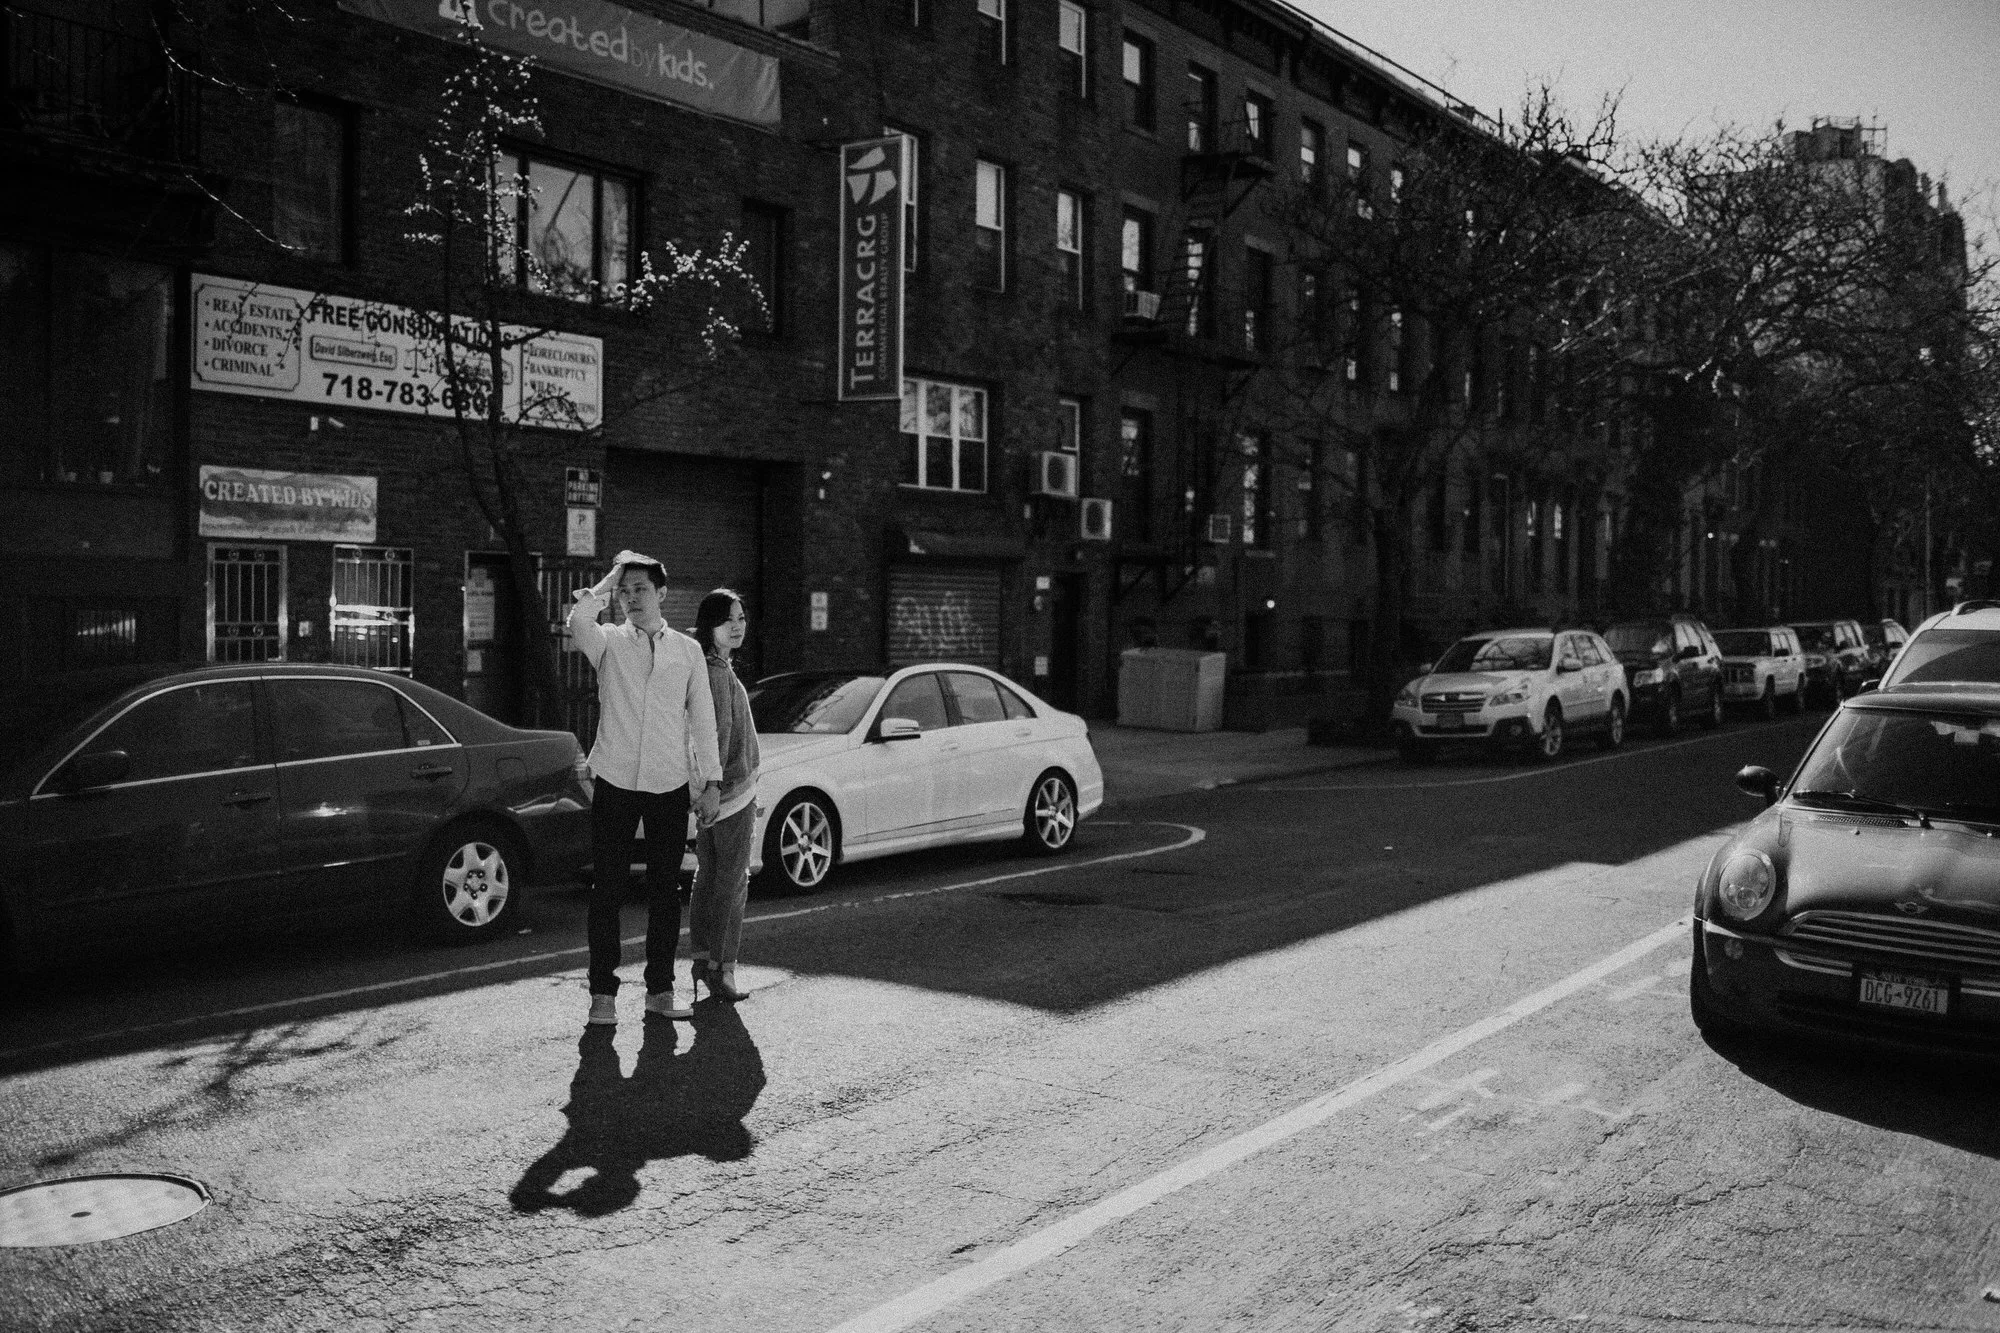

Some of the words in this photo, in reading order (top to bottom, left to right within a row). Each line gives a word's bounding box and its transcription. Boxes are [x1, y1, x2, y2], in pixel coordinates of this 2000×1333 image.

[880, 212, 890, 254] GROUP
[878, 258, 889, 298] REALTY
[249, 303, 293, 322] ESTATE
[310, 302, 361, 330] FREE
[850, 213, 877, 389] TERRACRG
[212, 337, 268, 357] DIVORCE
[878, 301, 888, 381] COMMERCIAL
[211, 357, 274, 377] CRIMINAL
[203, 480, 297, 506] CREATED
[301, 487, 325, 507] BY
[331, 489, 373, 510] KIDS
